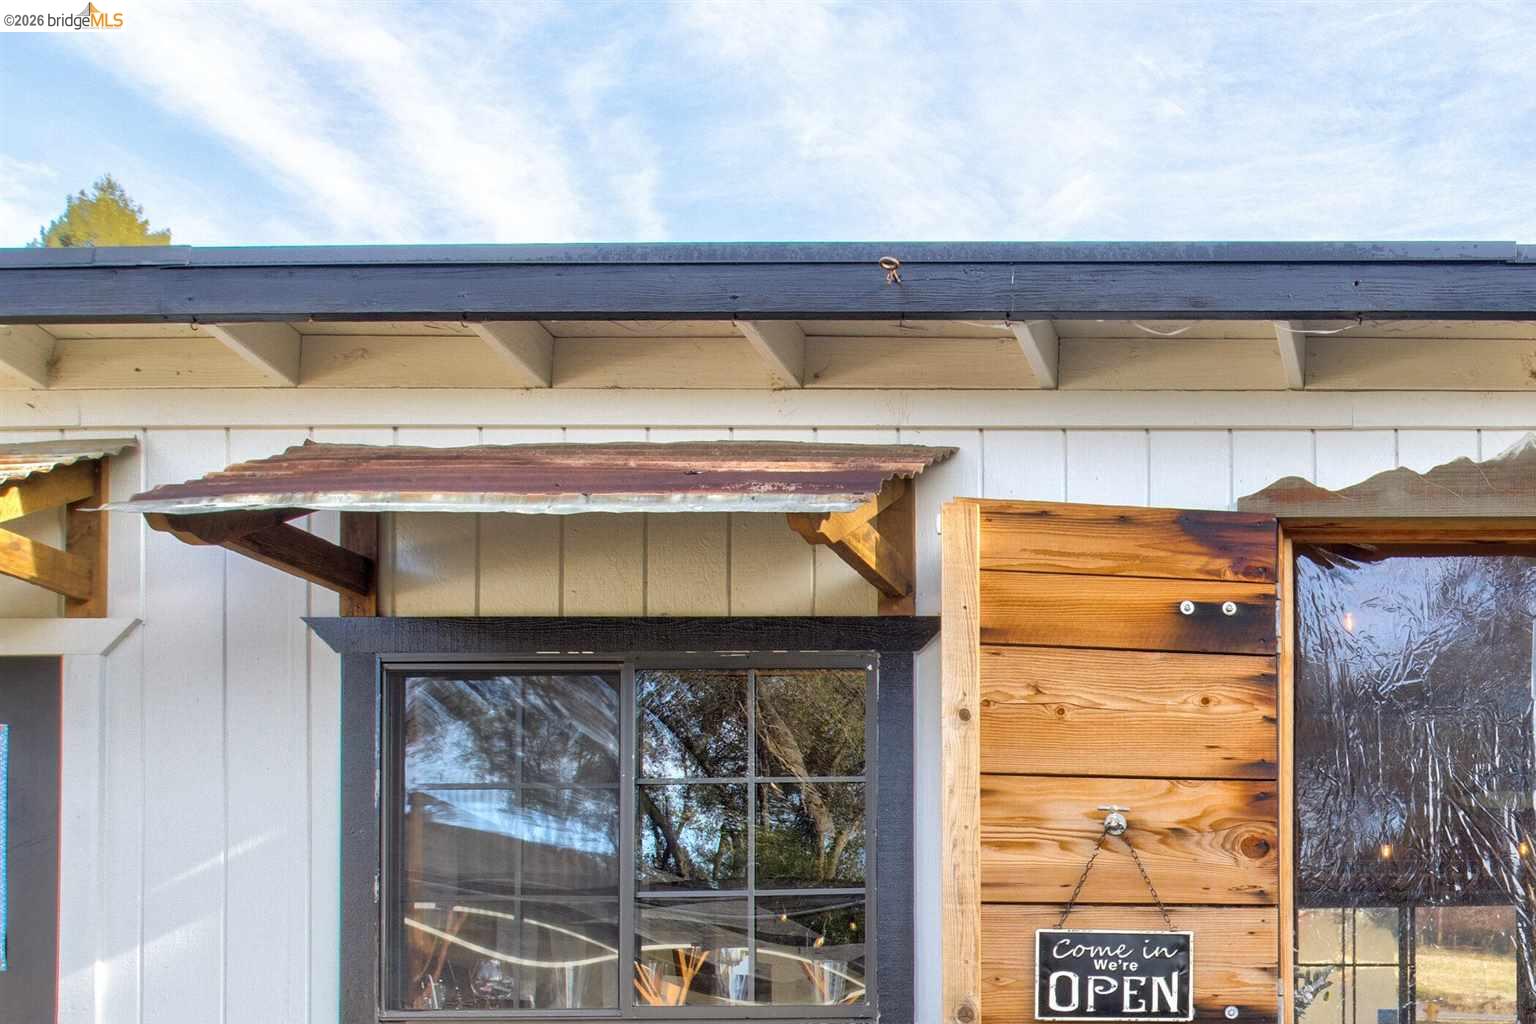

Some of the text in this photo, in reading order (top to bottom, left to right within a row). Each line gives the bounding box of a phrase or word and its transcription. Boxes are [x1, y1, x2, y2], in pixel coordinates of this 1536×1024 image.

[1052, 938, 1178, 959] Come in
[1094, 959, 1139, 971] We're
[1048, 970, 1180, 1013] OPEN
